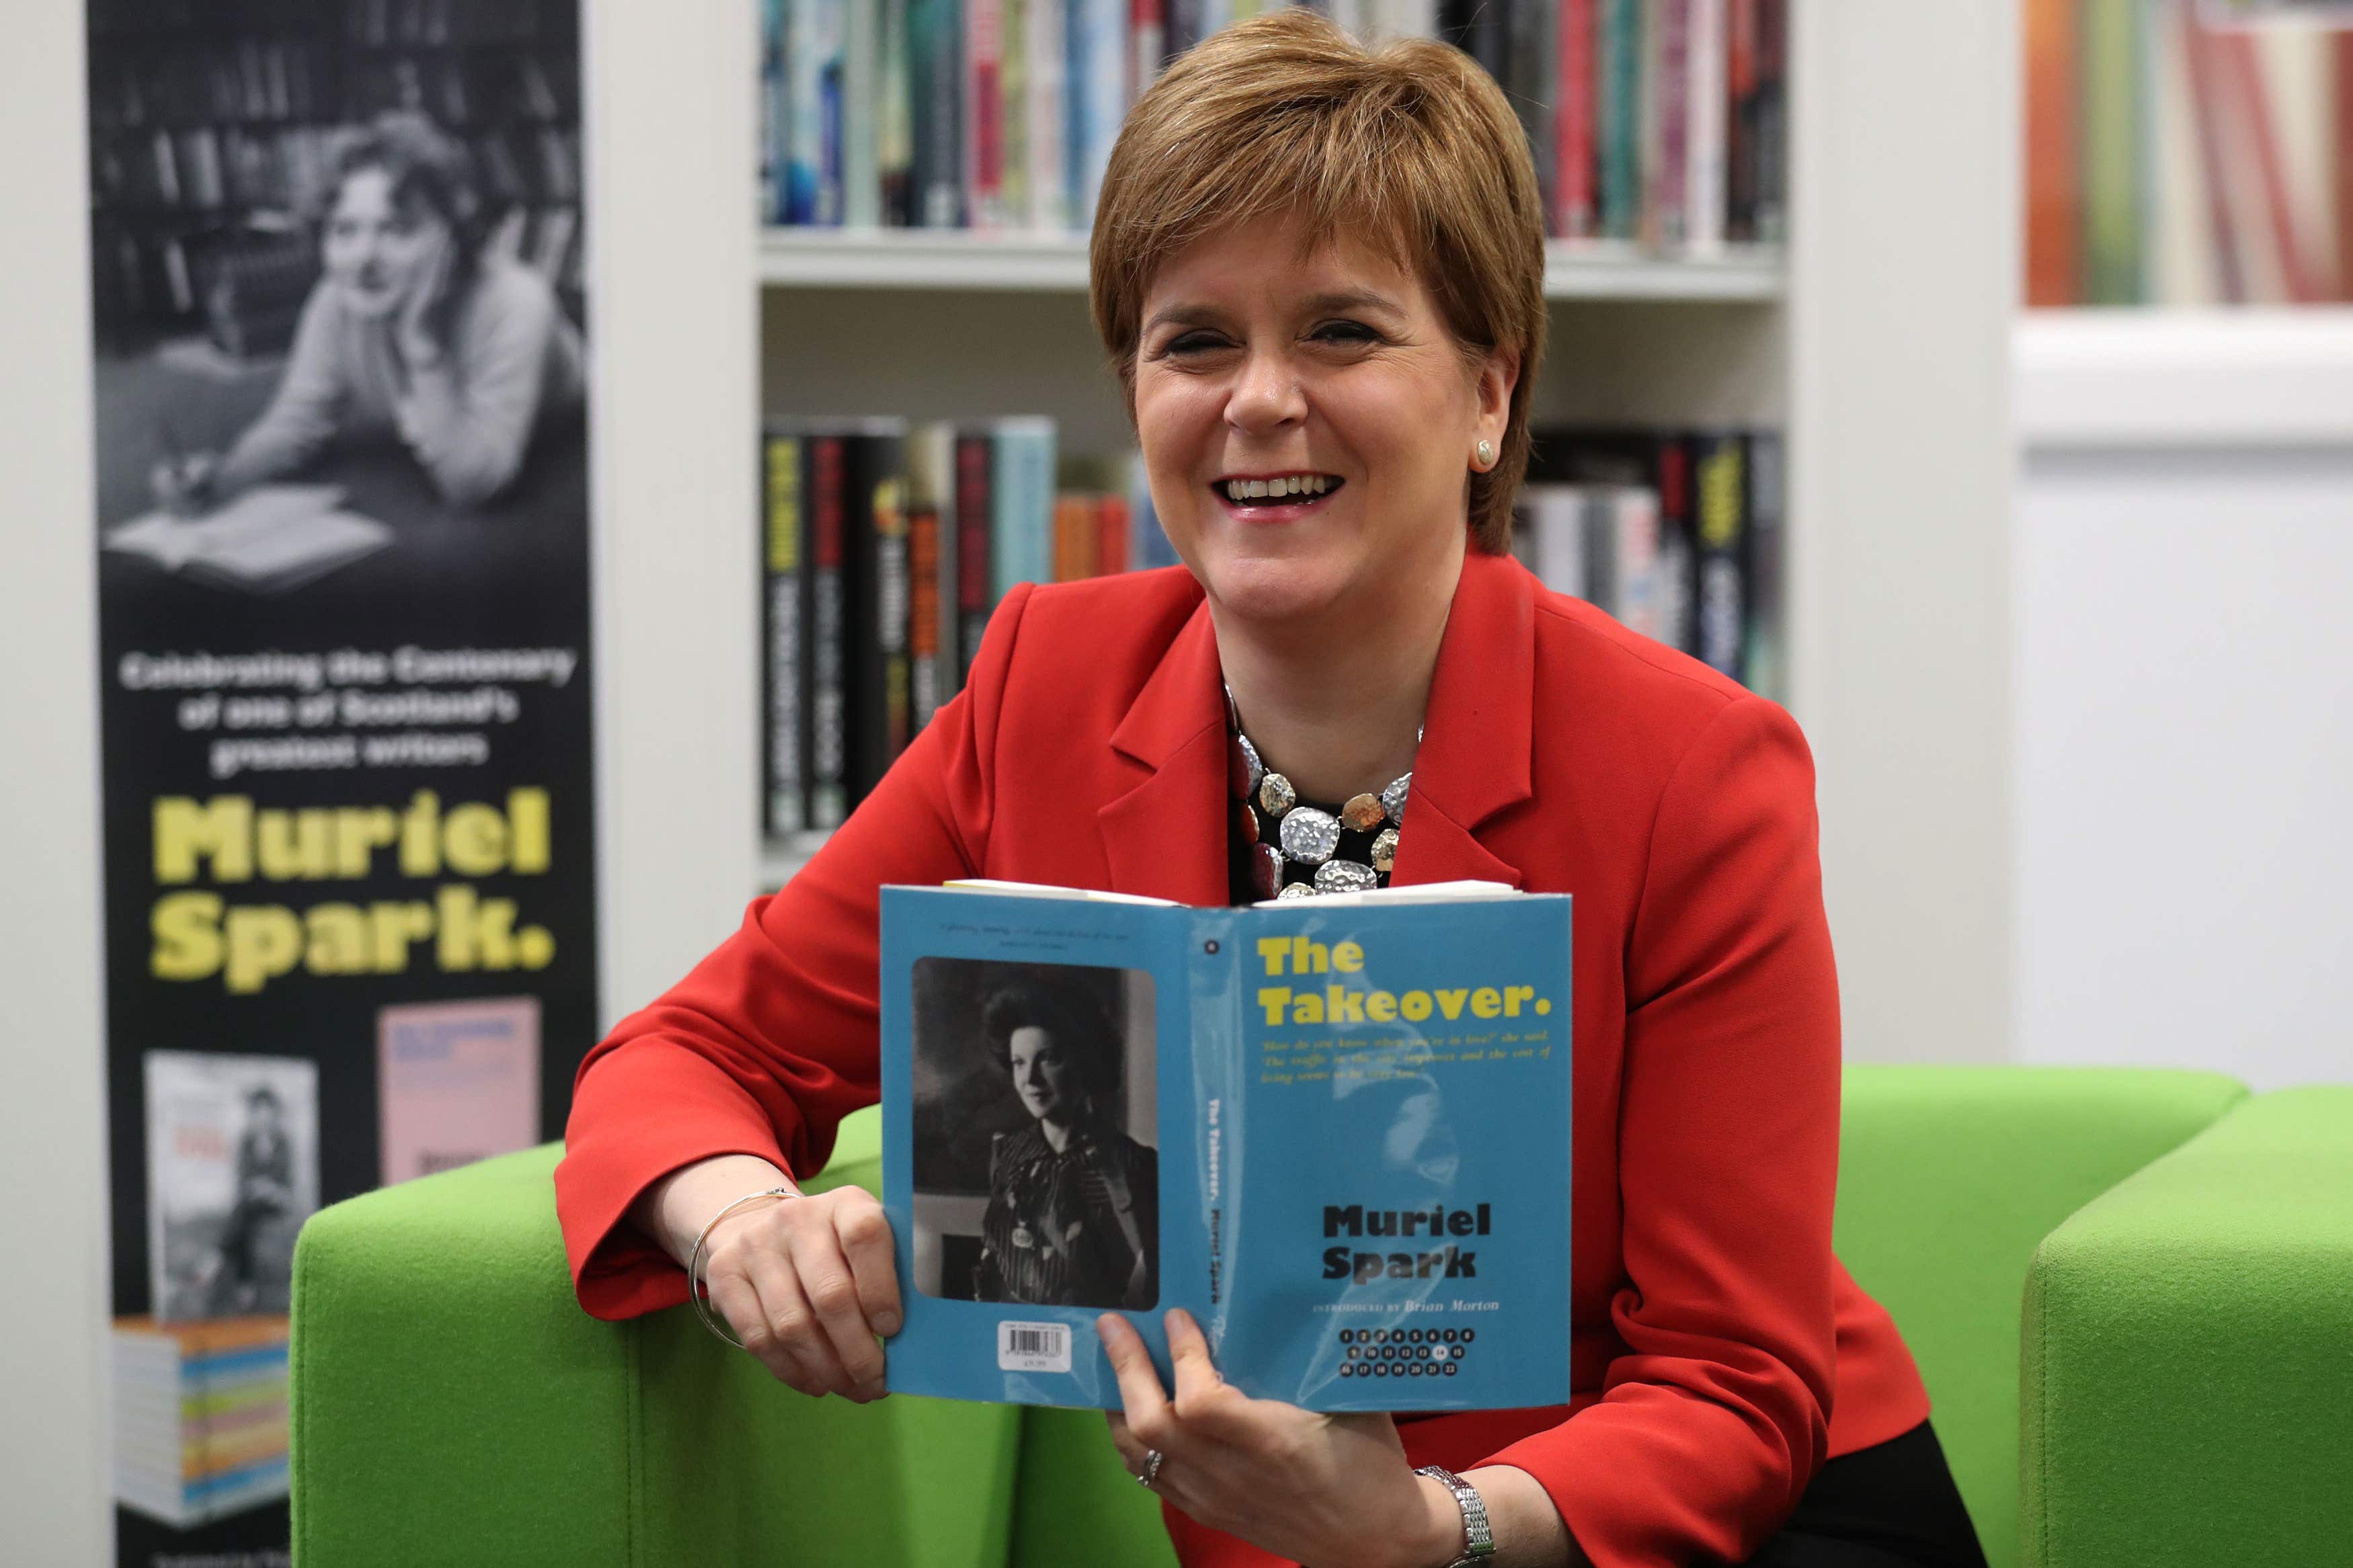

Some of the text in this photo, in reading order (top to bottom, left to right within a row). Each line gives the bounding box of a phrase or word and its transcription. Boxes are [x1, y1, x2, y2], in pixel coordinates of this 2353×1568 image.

[122, 645, 575, 691] Celebrating the Centenary
[177, 693, 221, 729] of
[223, 697, 292, 729] one
[295, 691, 336, 726] of
[210, 733, 489, 778] greatest writers
[153, 787, 550, 884] Muriel
[150, 884, 555, 993] Spark.
[1258, 936, 1364, 975] The
[1258, 985, 1551, 1026] Takeover.
[1462, 1050, 1484, 1062] and
[1489, 1049, 1507, 1060] the
[1502, 1032, 1520, 1043] she
[1209, 1098, 1220, 1125] The
[1211, 1208, 1221, 1257] Muriel
[1324, 1203, 1490, 1237] Muriel
[1209, 1260, 1221, 1304] Spark
[1322, 1246, 1476, 1285] Spark
[1387, 1304, 1399, 1313] BY
[1404, 1300, 1443, 1312] Brian
[1451, 1298, 1499, 1311] Morton
